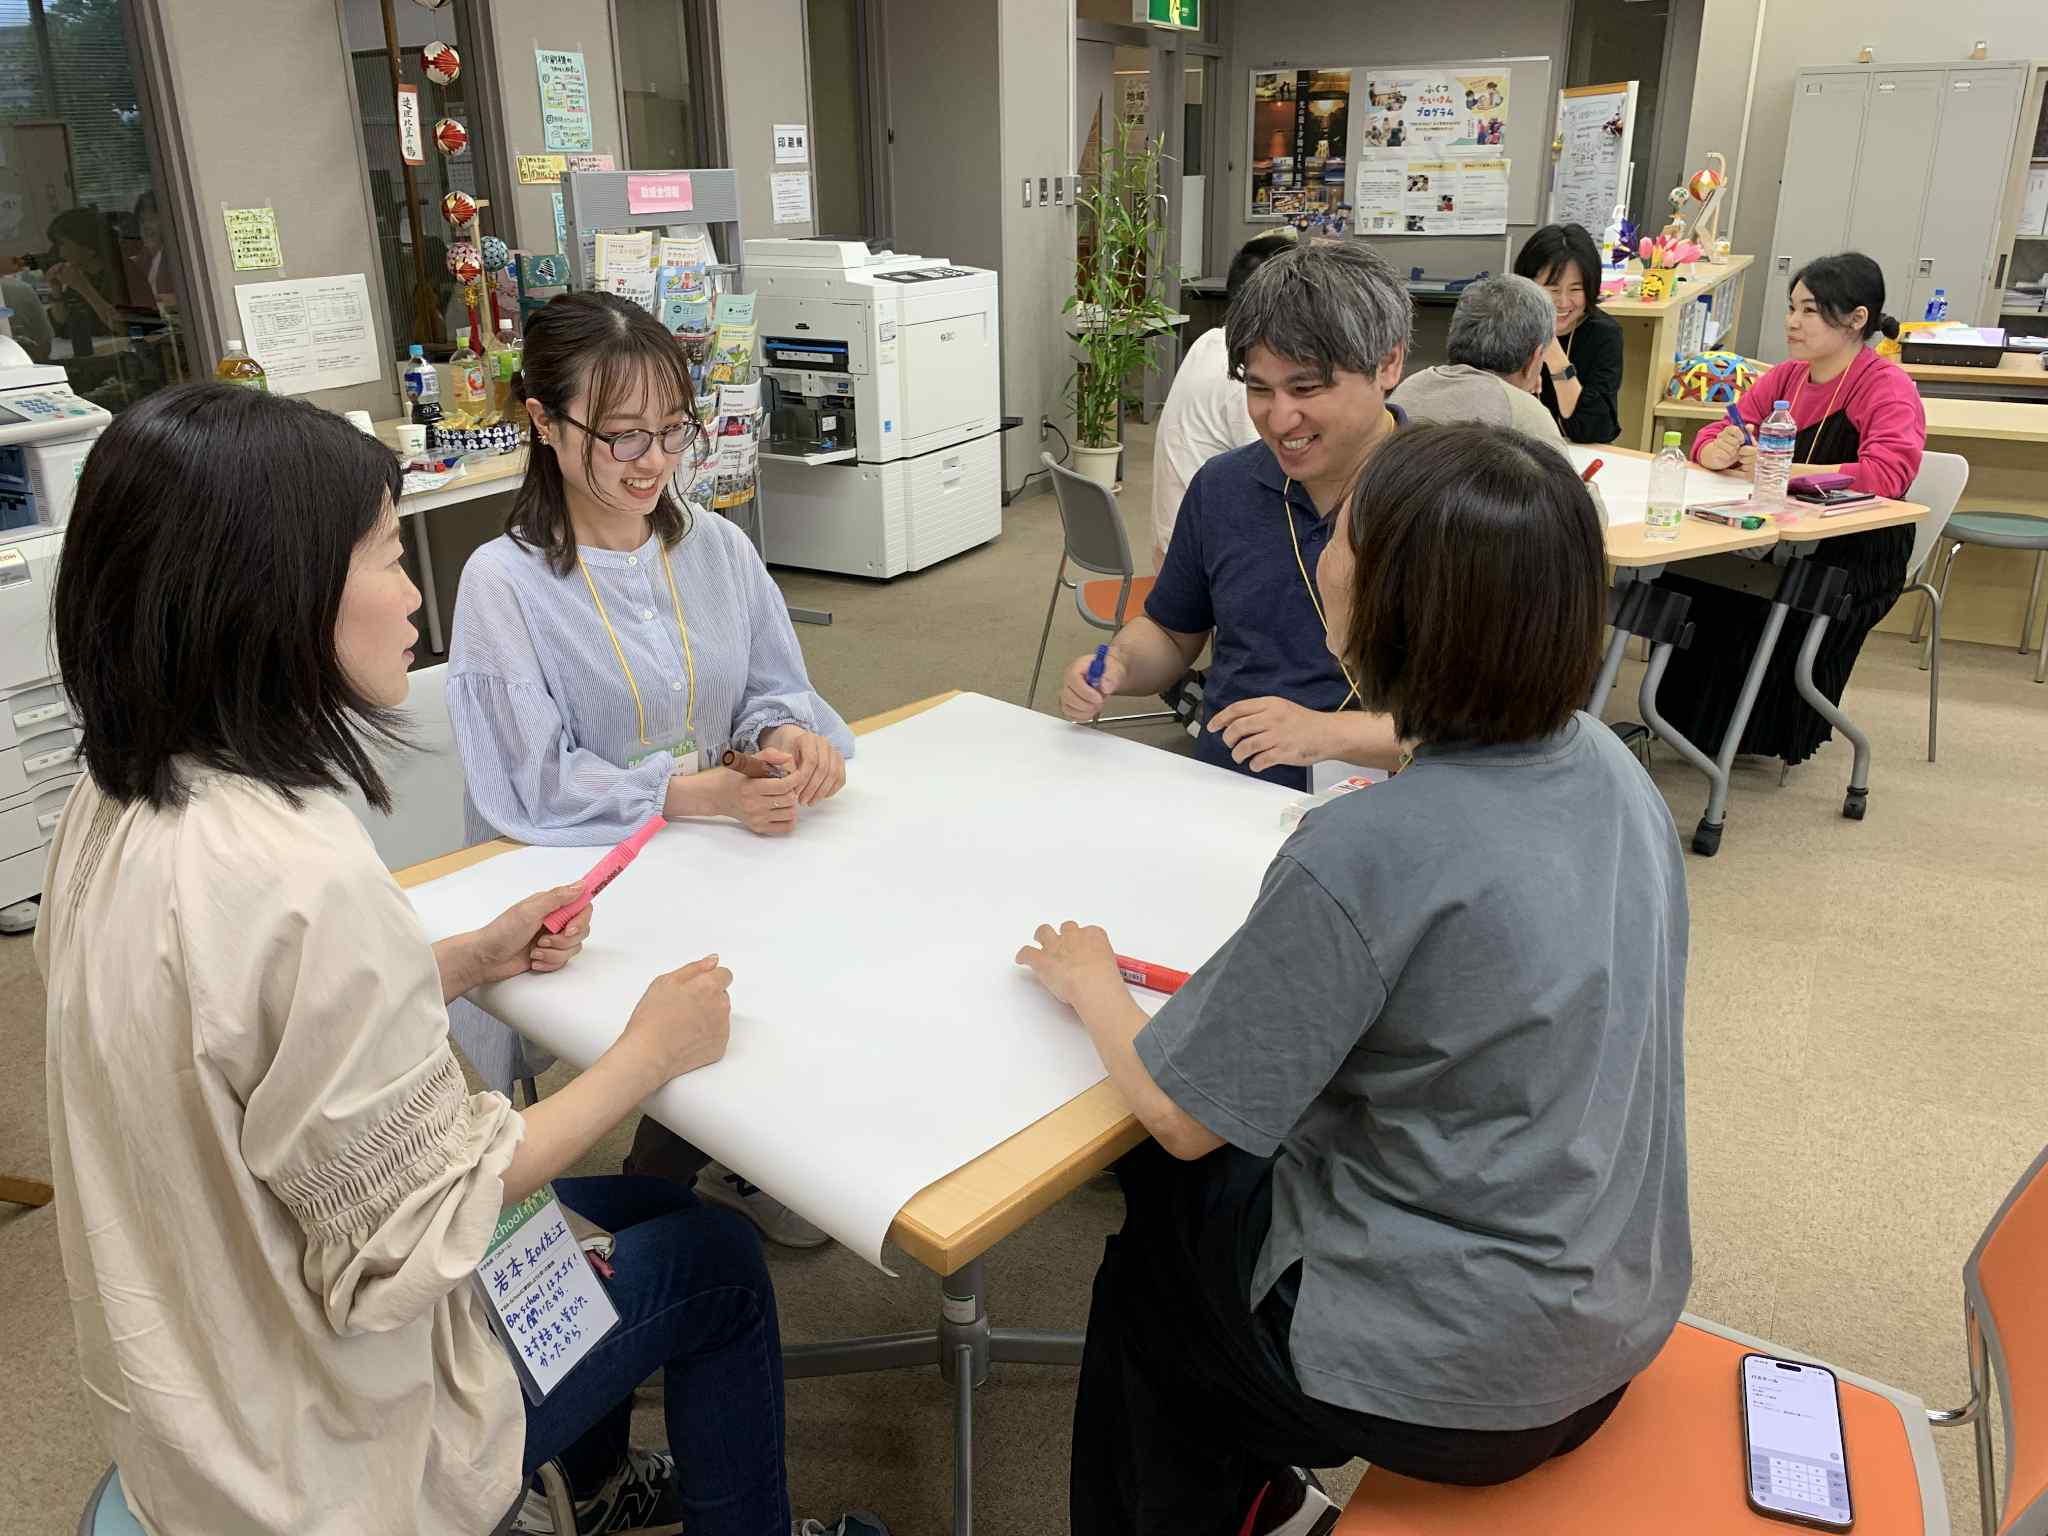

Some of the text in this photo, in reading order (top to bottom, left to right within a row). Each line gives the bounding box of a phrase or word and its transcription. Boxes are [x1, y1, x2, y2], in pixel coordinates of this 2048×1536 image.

[1416, 107, 1454, 117] プログラム
[493, 1257, 524, 1297] 岩本
